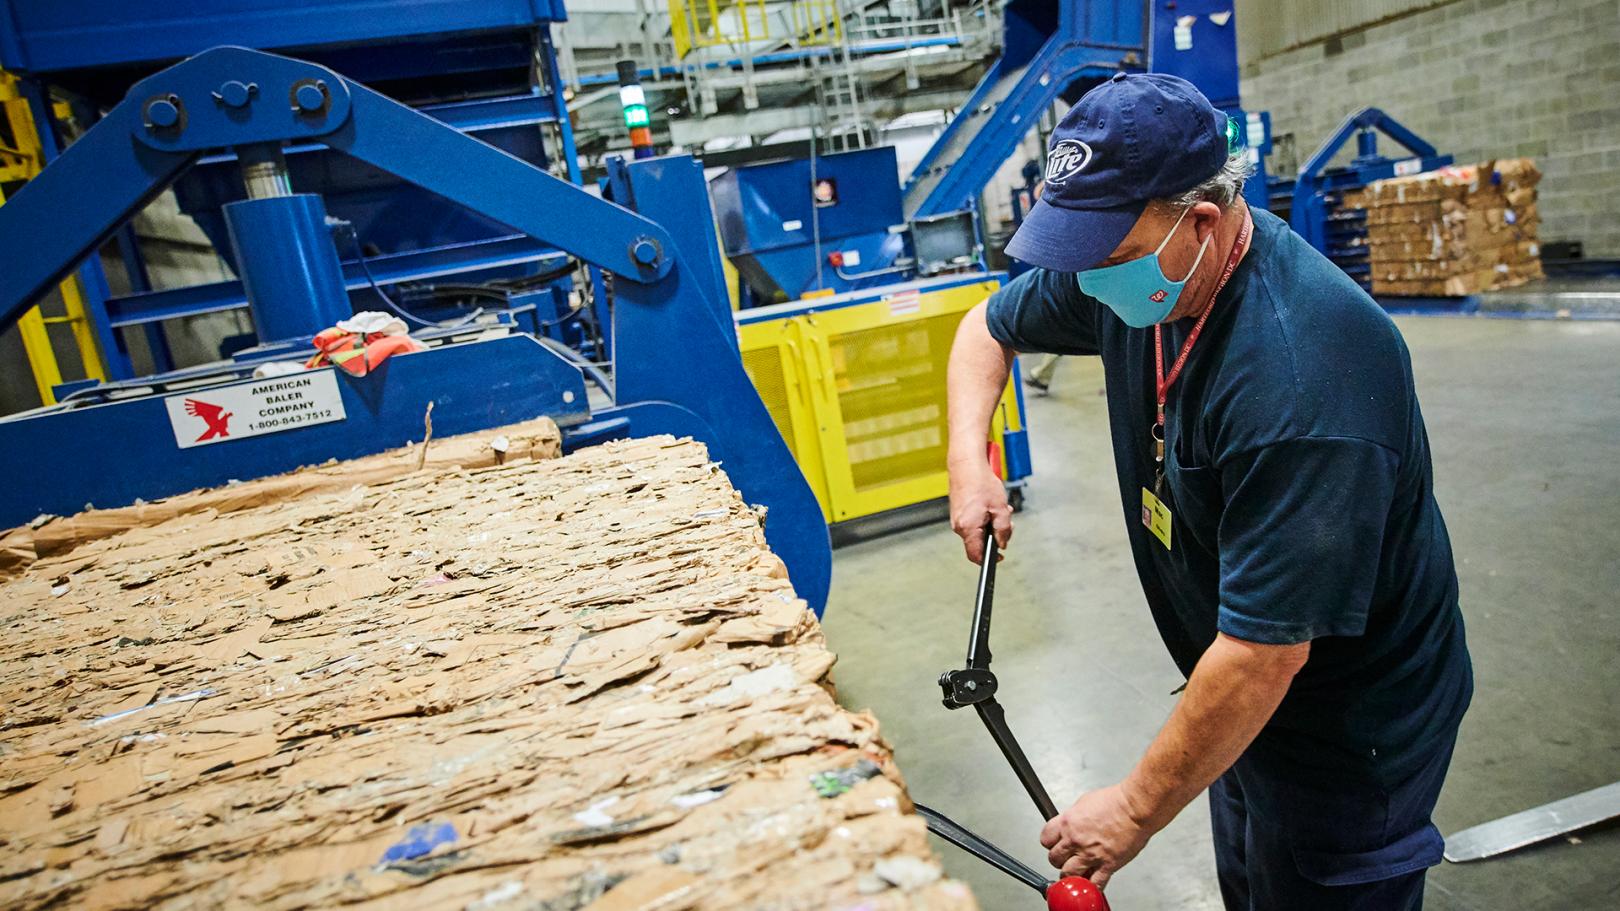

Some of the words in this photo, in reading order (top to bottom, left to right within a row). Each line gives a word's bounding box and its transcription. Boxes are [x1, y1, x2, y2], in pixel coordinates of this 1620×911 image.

[252, 378, 311, 396] AMERICAN
[265, 392, 303, 405] BALER
[258, 401, 314, 418] COMPANY
[248, 409, 332, 431] 1-800-843-7512
